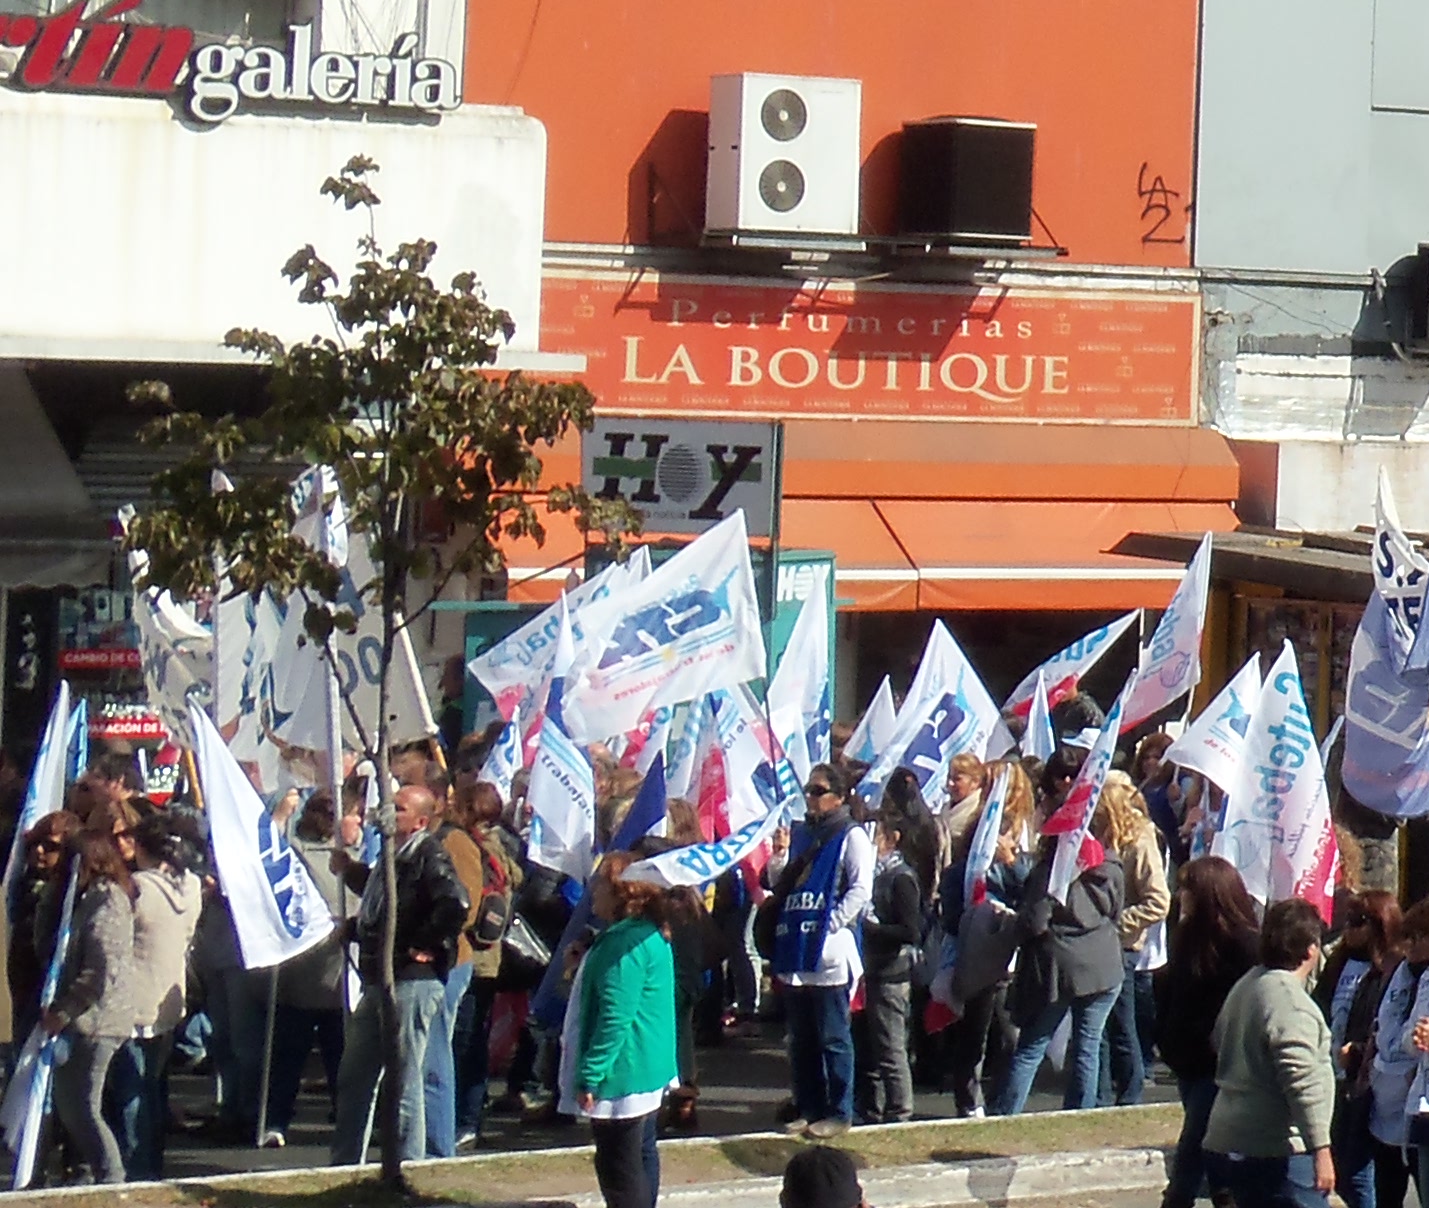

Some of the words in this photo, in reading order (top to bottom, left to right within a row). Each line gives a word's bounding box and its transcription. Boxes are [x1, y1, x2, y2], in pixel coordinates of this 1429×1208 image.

[189, 18, 462, 122] galería
[667, 298, 1033, 339] Perfumerias
[621, 336, 706, 386] LA
[727, 345, 1070, 403] BOUTIQUE
[593, 432, 763, 520] HOY
